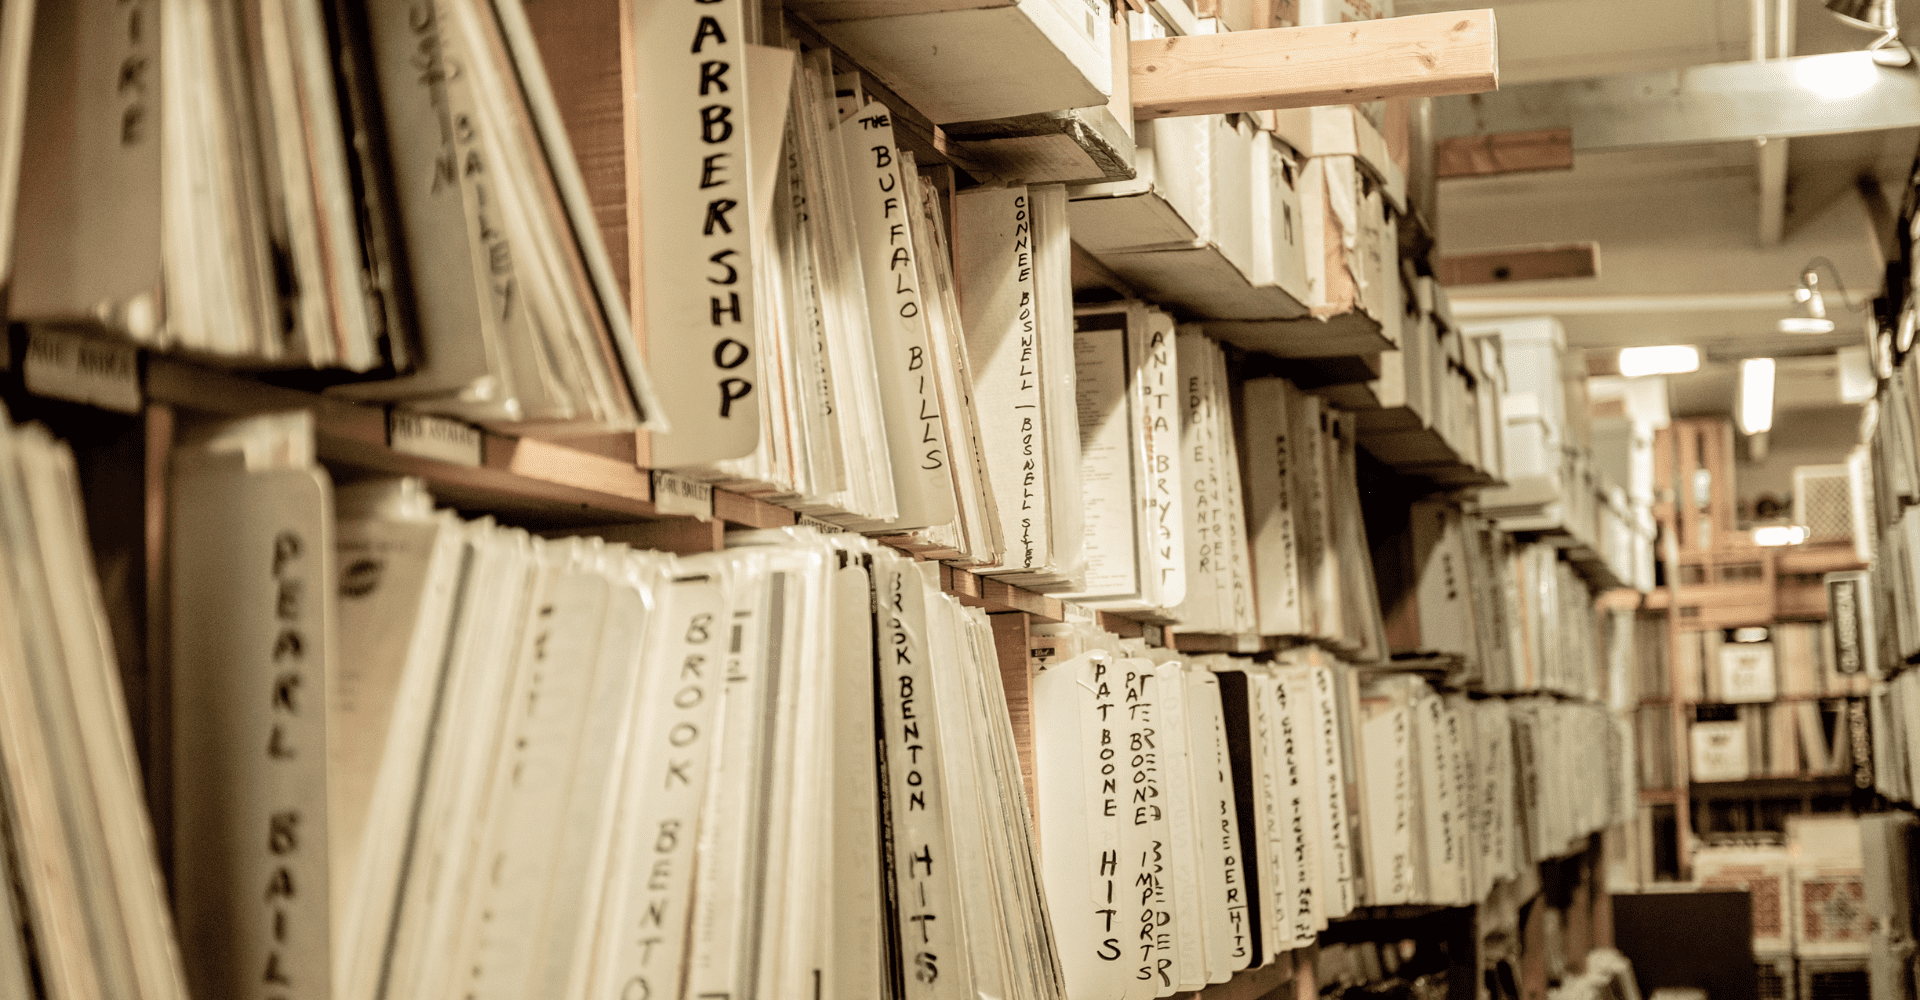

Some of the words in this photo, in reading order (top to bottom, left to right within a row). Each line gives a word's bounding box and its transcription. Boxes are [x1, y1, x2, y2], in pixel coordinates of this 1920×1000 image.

[859, 115, 890, 130] THE
[691, 0, 752, 418] ARBERSHOP
[872, 146, 918, 318] BUFFALO
[1014, 196, 1031, 282] CONNEE
[1019, 291, 1034, 391] BOSWELL
[1150, 331, 1170, 432] ANITA
[909, 346, 943, 470] BILLS
[1021, 417, 1035, 511] BOSWELL
[1194, 480, 1211, 574] CANTOR
[664, 613, 713, 787] BROOK
[1095, 664, 1114, 722] PAT
[1125, 672, 1141, 721] PAT
[898, 676, 925, 812] BENTON
[1100, 729, 1117, 818] BOONE
[1130, 733, 1148, 826] BOONE
[262, 810, 300, 1000] BAIL
[909, 845, 937, 984] HITS
[1096, 849, 1121, 961] HITS
[1134, 851, 1153, 980] IMPORTS
